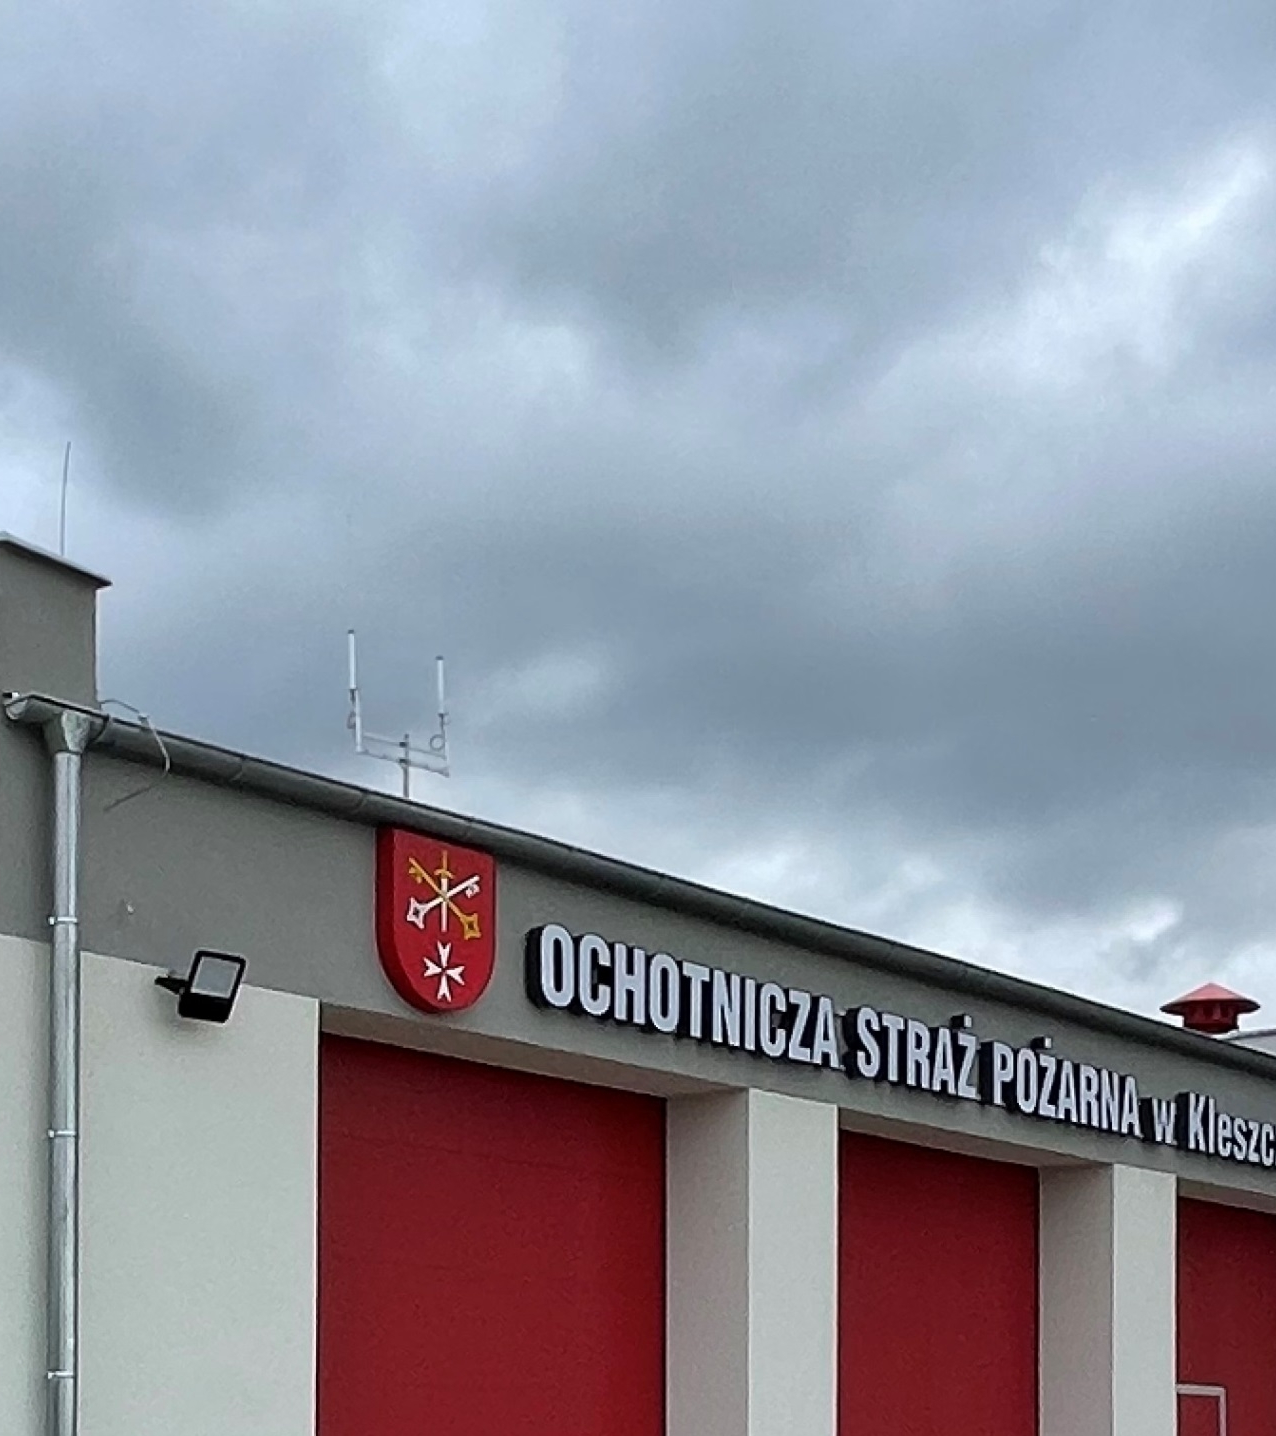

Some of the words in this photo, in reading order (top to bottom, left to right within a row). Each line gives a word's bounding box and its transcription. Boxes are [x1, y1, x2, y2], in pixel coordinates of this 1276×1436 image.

[531, 923, 844, 1070] OCHOTNICZA
[851, 1005, 980, 1100] STRAŻ
[987, 1036, 1143, 1138] POŻARNA
[1149, 1097, 1177, 1146] w
